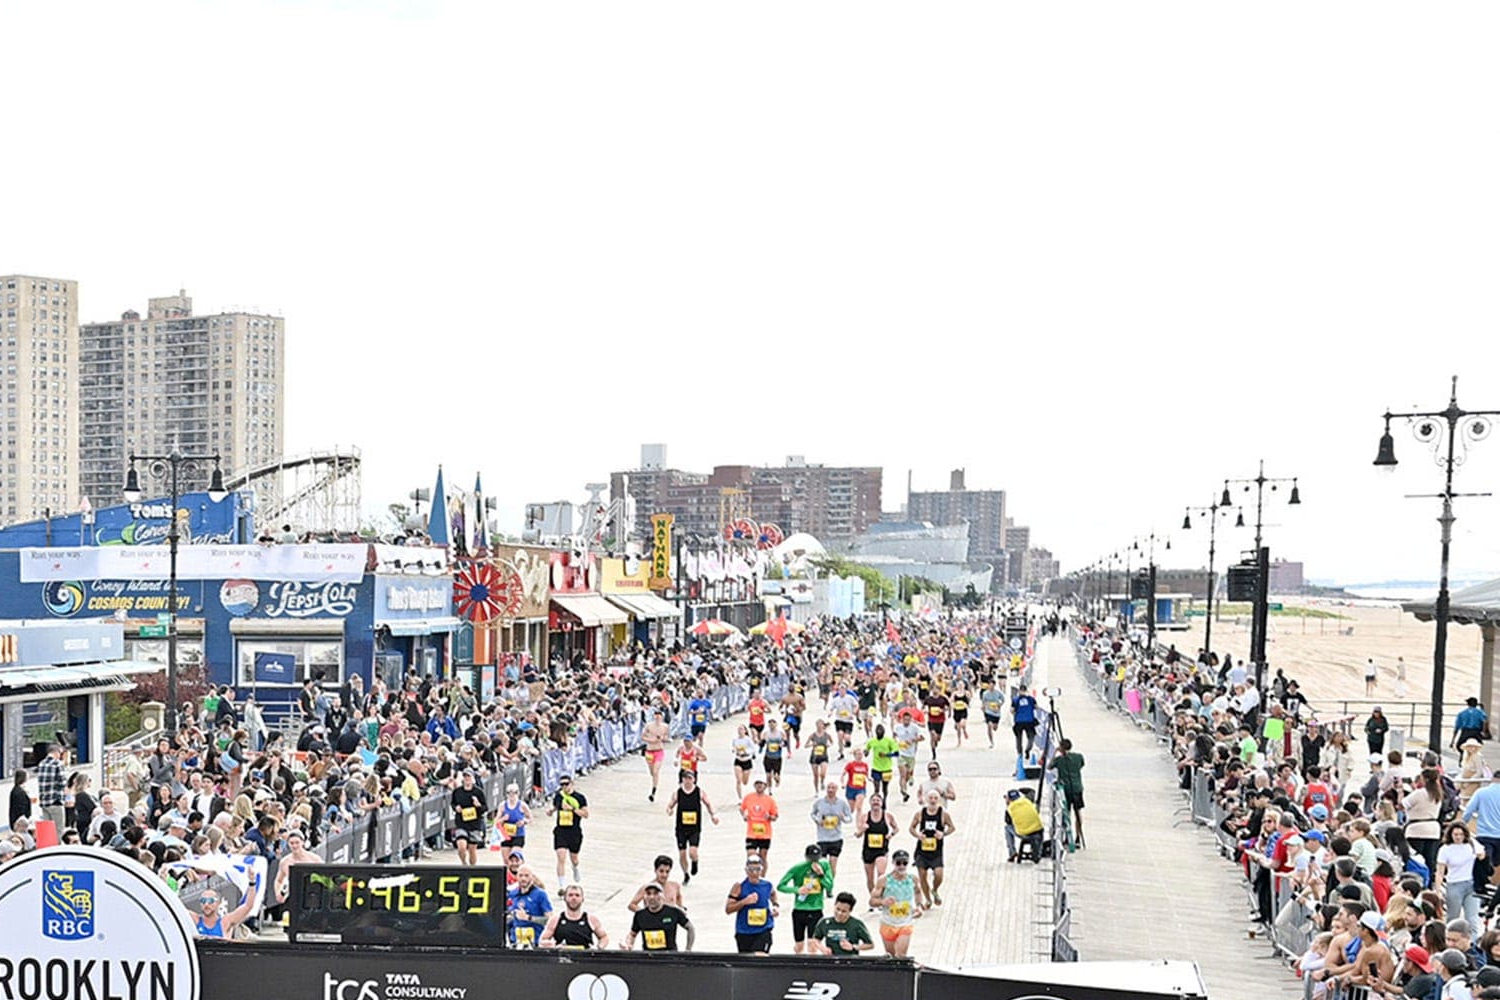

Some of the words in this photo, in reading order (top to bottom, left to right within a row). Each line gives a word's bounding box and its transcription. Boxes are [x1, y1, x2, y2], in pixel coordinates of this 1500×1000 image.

[130, 502, 174, 519] Tom's
[87, 596, 133, 610] COSMOS
[134, 596, 191, 610] COUNTY!
[47, 919, 91, 936] RBC
[385, 973, 420, 985] TATA
[385, 985, 467, 1000] CONSULTANCY
